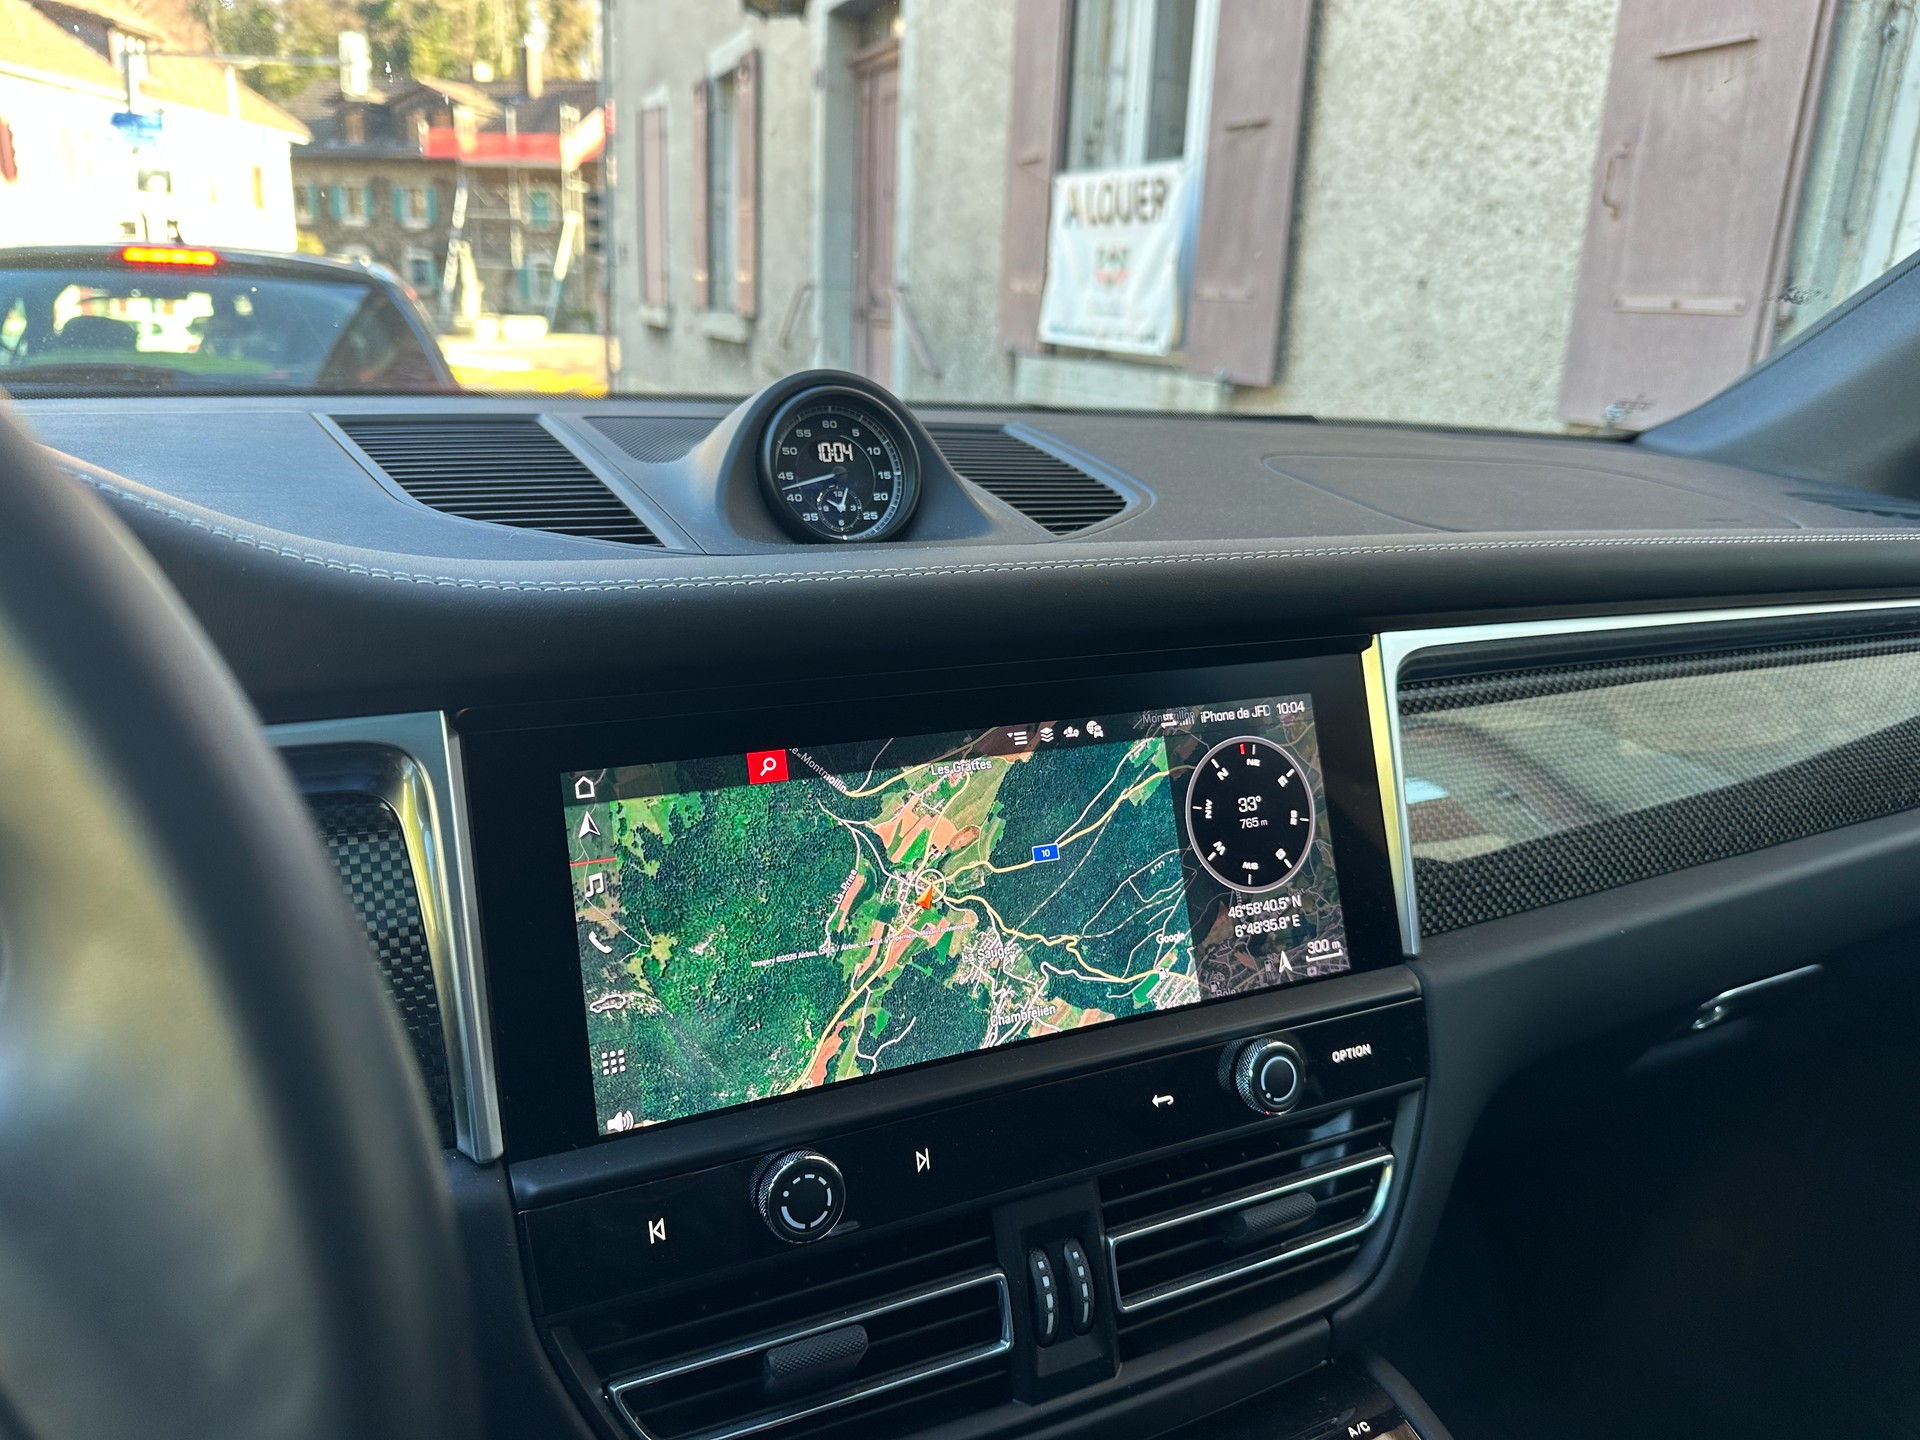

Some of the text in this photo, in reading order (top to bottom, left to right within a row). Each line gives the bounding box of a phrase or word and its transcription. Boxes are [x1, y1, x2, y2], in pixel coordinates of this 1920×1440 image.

[822, 420, 837, 428] 60
[796, 429, 812, 438] 55
[852, 429, 860, 437] 5
[782, 447, 798, 456] 50
[817, 442, 853, 463] 10:04
[867, 447, 881, 456] 10
[778, 472, 794, 481] 45
[878, 471, 892, 480] 15
[787, 494, 803, 503] 40
[833, 490, 843, 498] 12
[873, 493, 889, 502] 20
[850, 504, 857, 513] 3
[803, 512, 819, 522] 35
[863, 511, 879, 521] 25
[1276, 700, 1305, 715] 10:04
[1200, 710, 1235, 723] iPhone
[1236, 706, 1250, 719] de
[931, 759, 992, 776] Les Grattes
[1246, 757, 1261, 768] NE
[800, 752, 848, 794] Montmollin
[1216, 767, 1230, 781] N
[1277, 774, 1289, 788] E
[1204, 799, 1213, 819] NW
[1237, 795, 1262, 813] 33°
[1239, 816, 1269, 830] 765 m
[1041, 850, 1051, 858] 10
[1212, 840, 1226, 856] W
[1291, 894, 1302, 908] N
[1291, 914, 1301, 927] E
[1156, 932, 1184, 944] Google
[1307, 938, 1341, 954] 300 m
[962, 947, 1011, 963] La Sauge
[990, 1005, 1056, 1027] Chambrelien
[1332, 1044, 1372, 1063] OPTION
[1347, 1421, 1371, 1439] A/C
